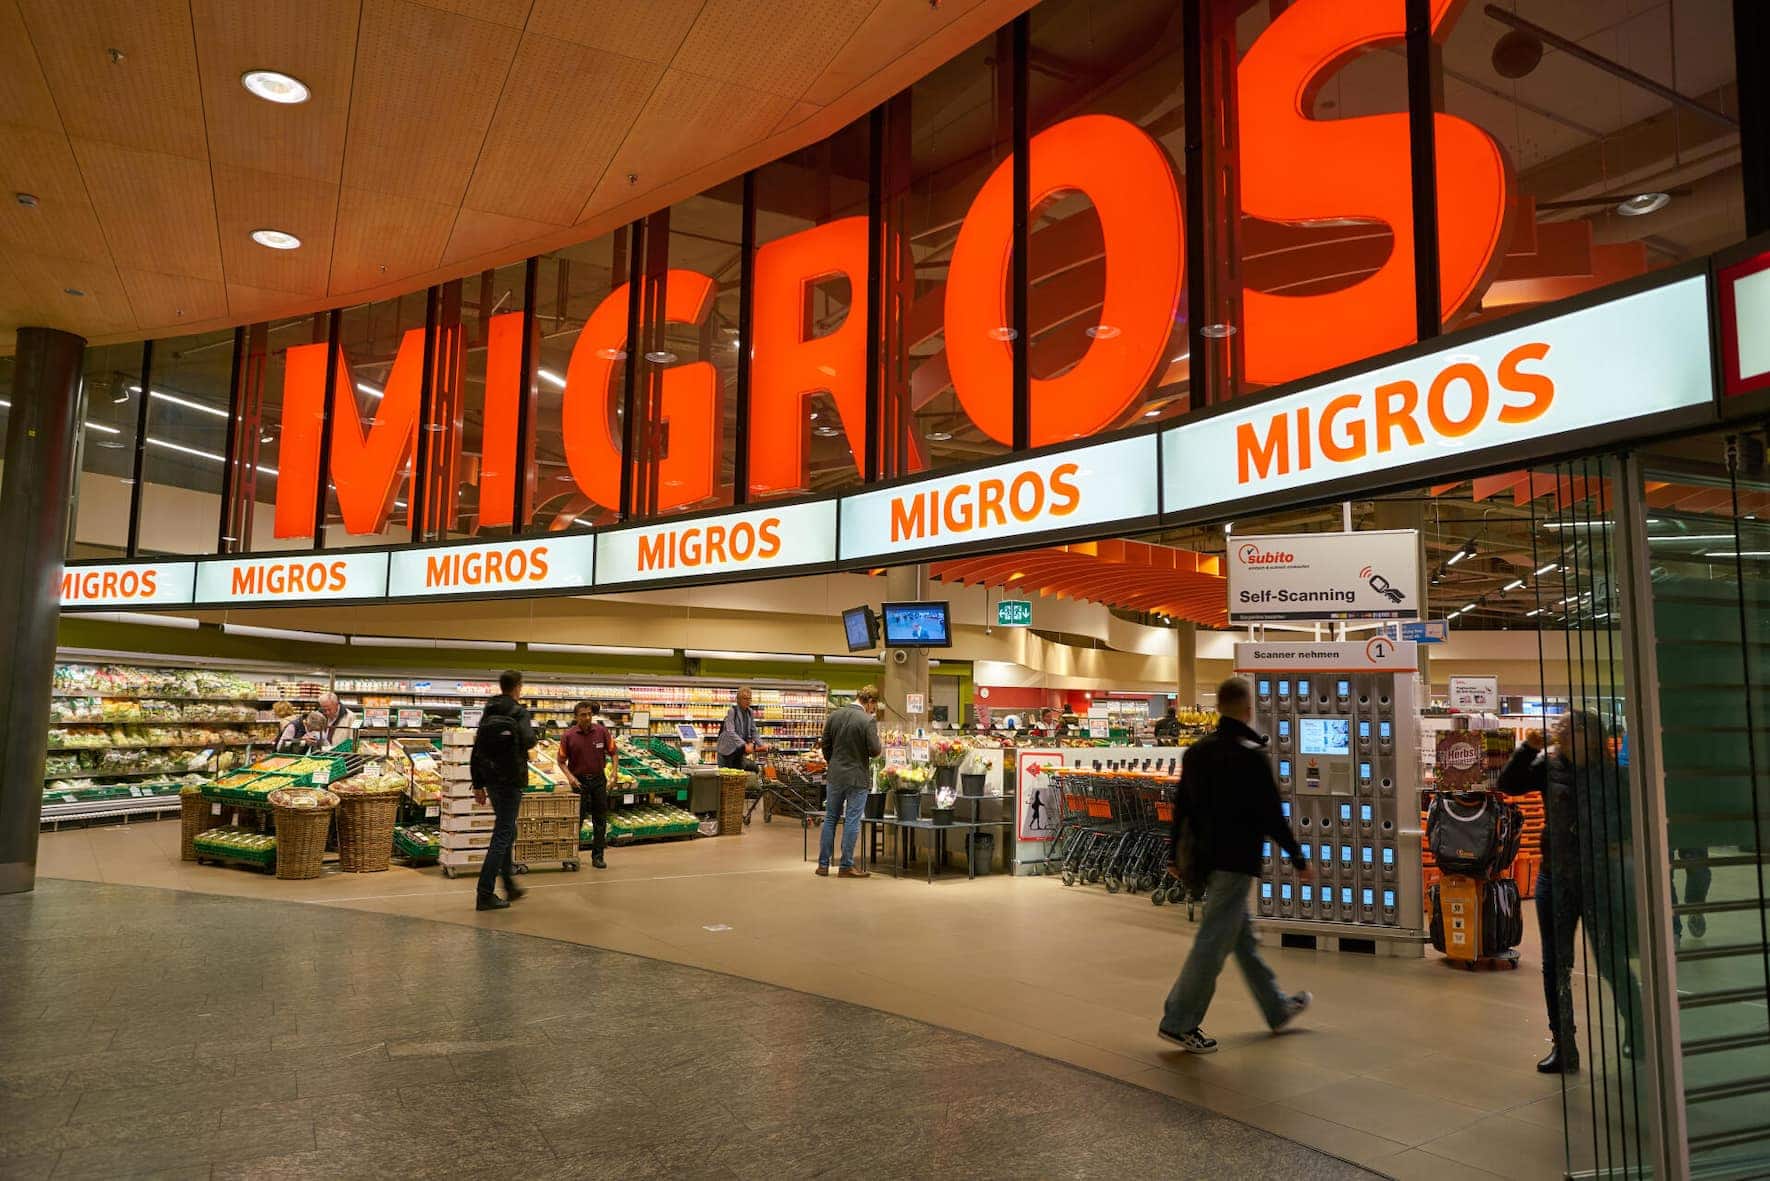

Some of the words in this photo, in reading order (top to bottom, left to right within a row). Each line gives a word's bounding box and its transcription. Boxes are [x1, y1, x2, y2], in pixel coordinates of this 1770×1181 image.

[275, 0, 1512, 540] MIGROS
[1237, 343, 1555, 483] MIGROS
[890, 464, 1081, 542] MIGROS
[638, 520, 781, 572] MIGROS
[1248, 552, 1294, 564] subito
[232, 561, 347, 595] MIGROS
[426, 547, 548, 587] MIGROS
[1240, 588, 1356, 603] Self-Scanning
[1254, 650, 1296, 659] Scanner
[1298, 650, 1340, 659] nehmen
[1376, 643, 1385, 658] 1
